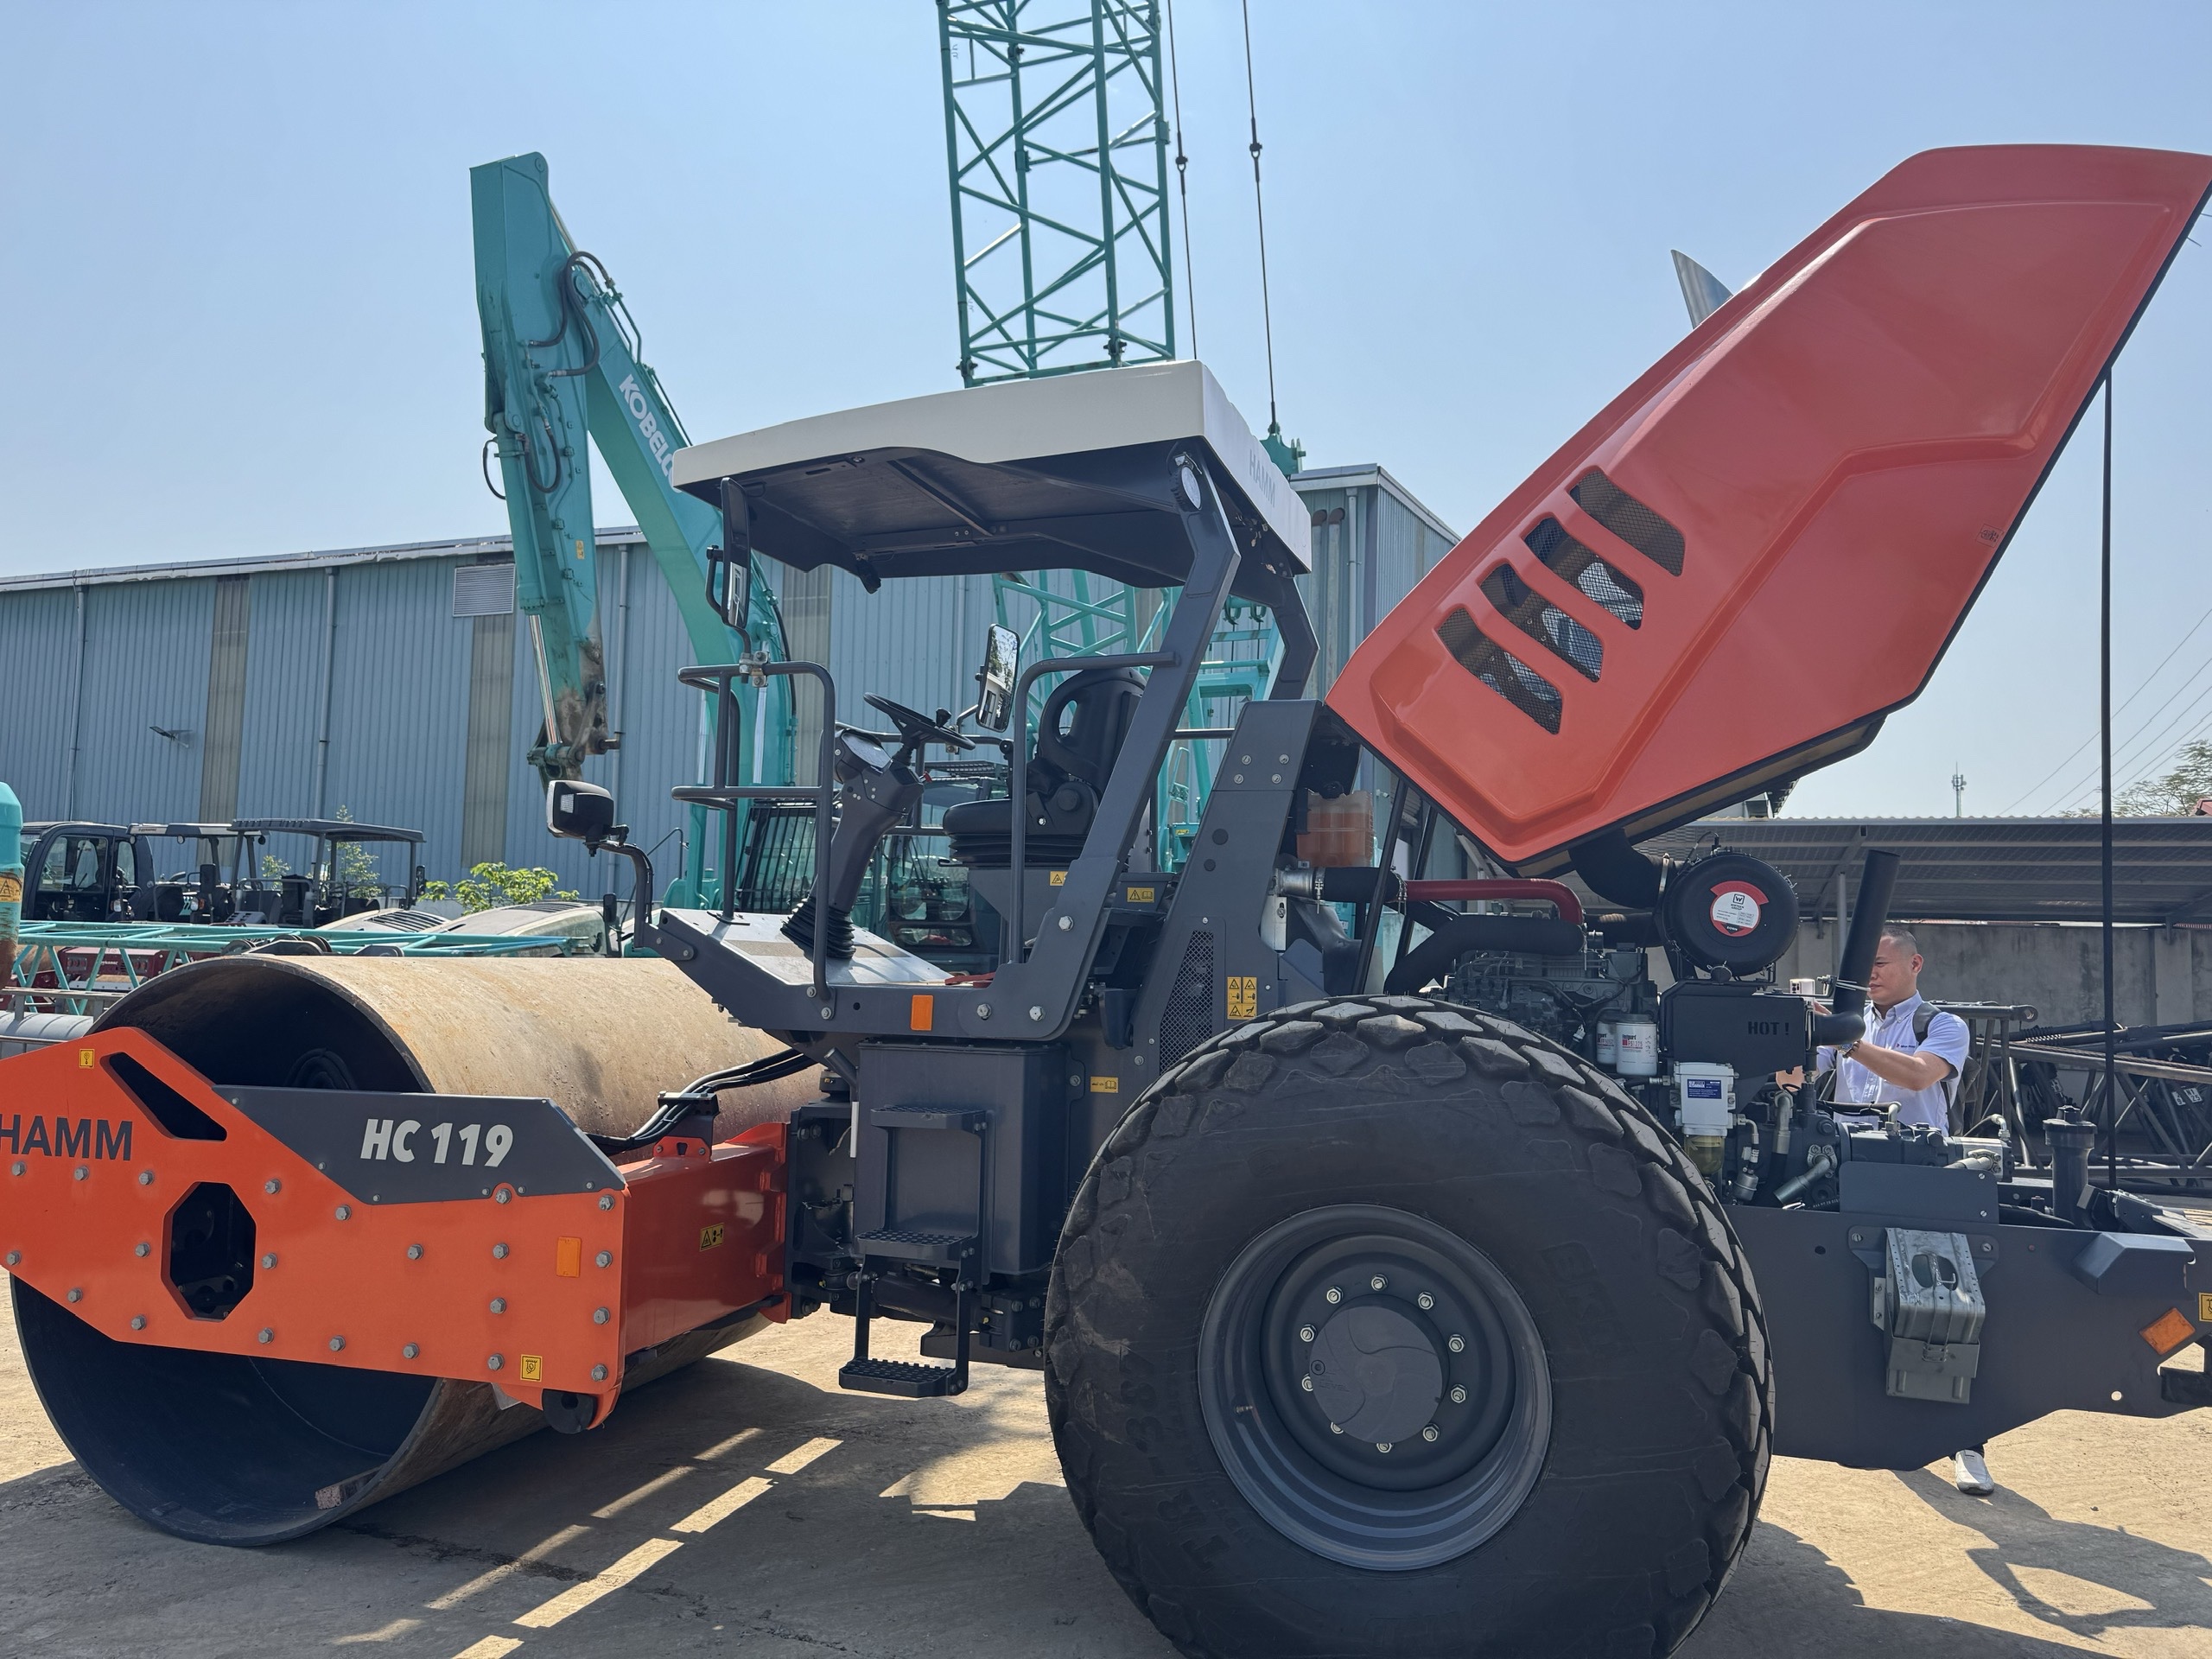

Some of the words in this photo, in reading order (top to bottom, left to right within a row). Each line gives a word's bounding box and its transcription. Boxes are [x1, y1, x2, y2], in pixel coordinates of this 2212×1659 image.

[619, 373, 682, 493] KOBELC
[1249, 448, 1276, 508] HAMM
[1748, 1021, 1780, 1035] HOT
[1784, 1022, 1789, 1035] !
[0, 1114, 133, 1161] HAMM
[359, 1118, 422, 1163] HC
[430, 1122, 514, 1167] 119
